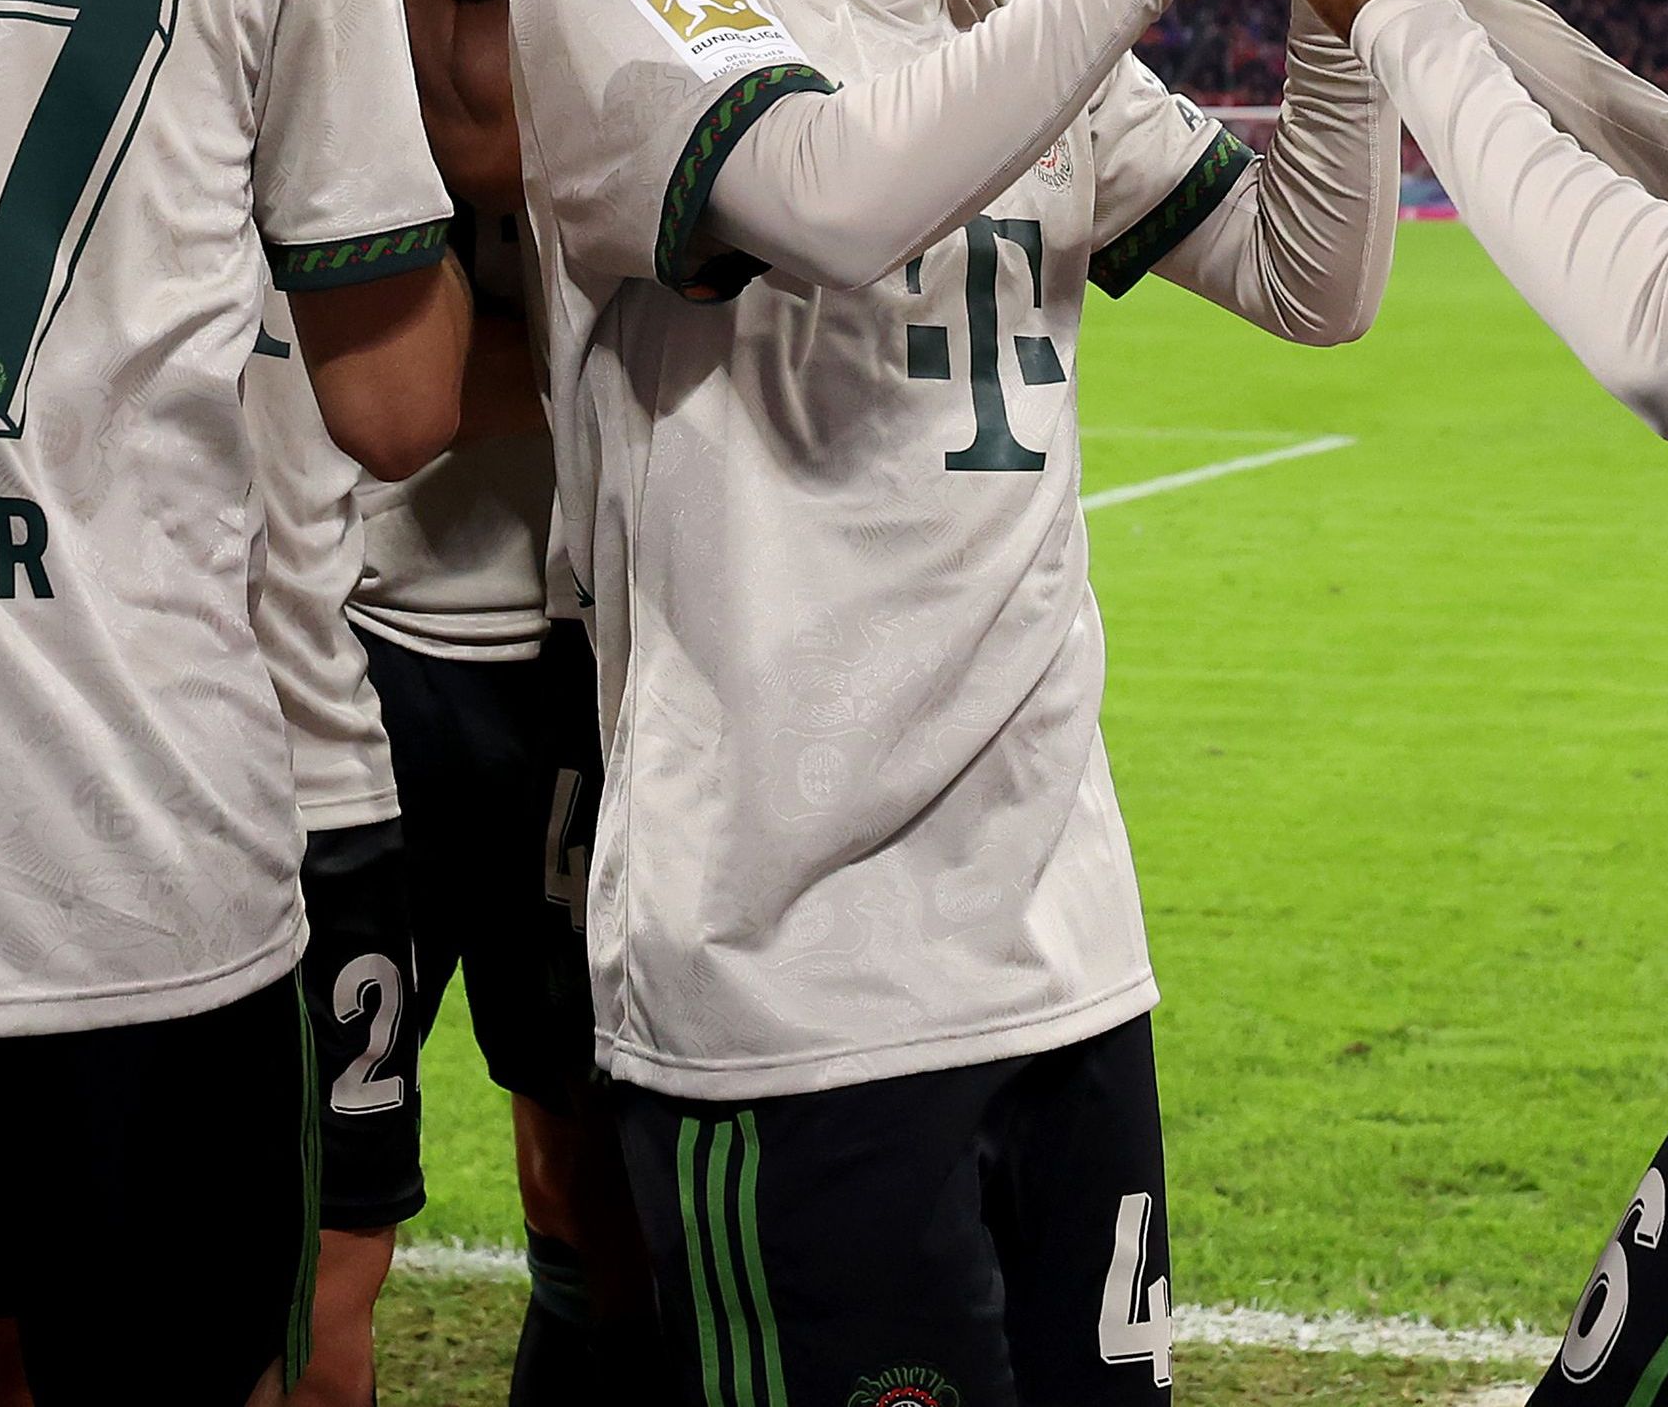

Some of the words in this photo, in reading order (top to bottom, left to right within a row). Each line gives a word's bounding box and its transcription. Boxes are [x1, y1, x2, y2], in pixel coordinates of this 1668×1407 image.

[544, 767, 589, 934] 4
[331, 937, 420, 1115] 2
[1098, 1192, 1174, 1389] 4
[1562, 1167, 1667, 1384] 6
